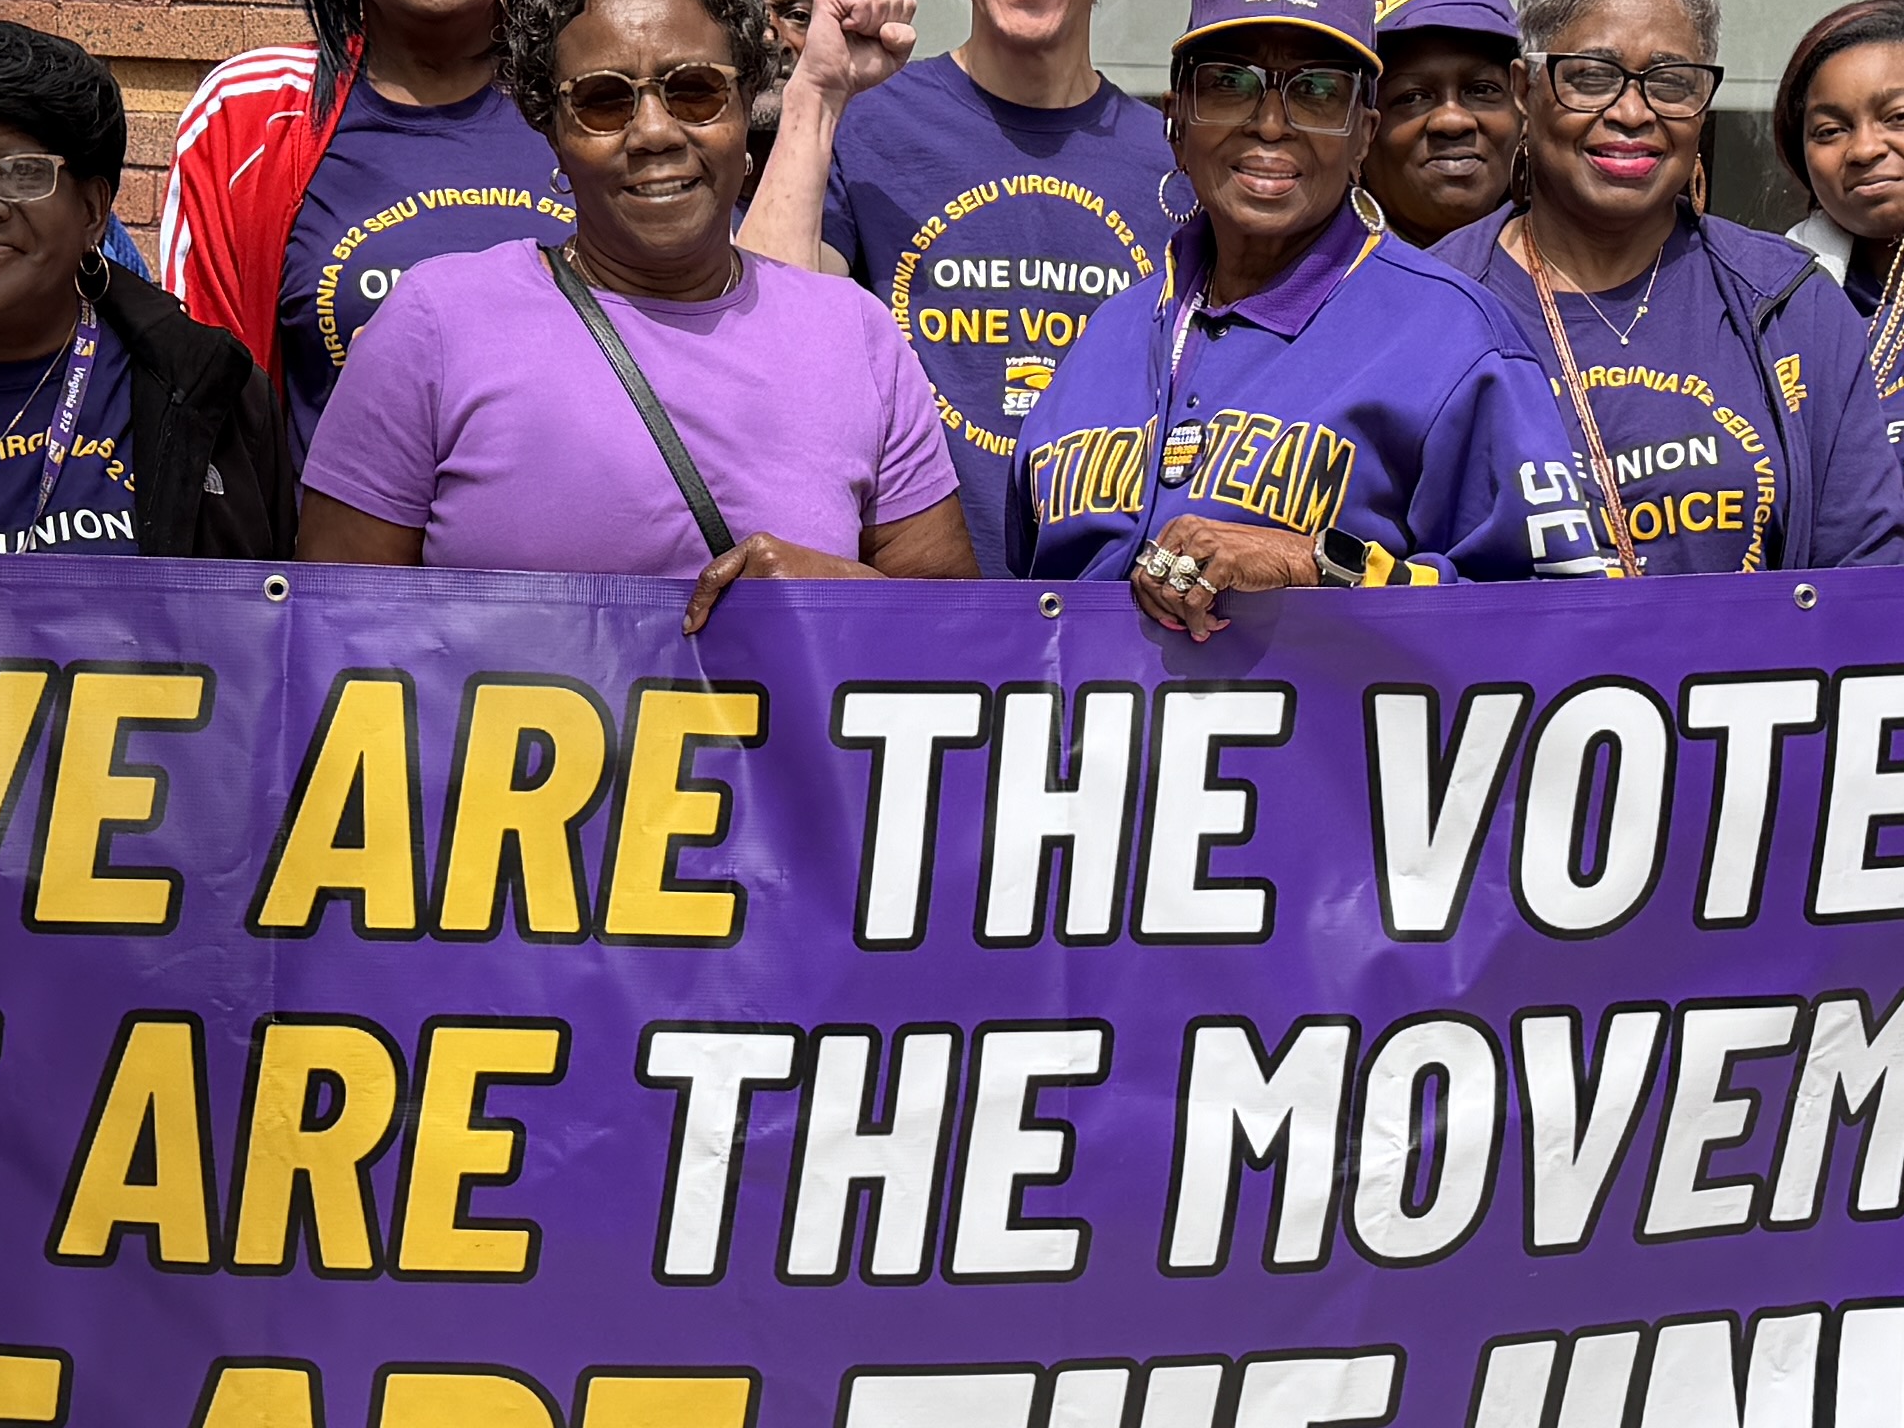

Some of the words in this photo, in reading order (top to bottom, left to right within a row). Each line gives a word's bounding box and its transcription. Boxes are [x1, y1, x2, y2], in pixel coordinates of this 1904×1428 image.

[316, 263, 347, 367] IRGINIA
[332, 226, 368, 260] 512
[363, 196, 419, 233] SEIU
[418, 187, 533, 210] VIRGINIA
[536, 197, 577, 223] 512
[911, 216, 947, 251] 512
[944, 181, 1000, 221] SEIU
[1001, 174, 1105, 217] VIRGINIA
[1105, 210, 1135, 247] 512
[1130, 244, 1155, 279] SE
[934, 258, 1011, 288] ONE
[1019, 259, 1130, 296] UNION
[919, 308, 1010, 344] ONE
[1019, 307, 1088, 346] VOI
[1002, 391, 1040, 409] SEI
[1580, 365, 1679, 393] IRGINIA
[1681, 374, 1715, 406] 512
[1712, 406, 1765, 453] SEIU
[1188, 409, 1356, 536] TEAM
[247, 668, 768, 949] ARE
[831, 679, 1296, 951] THE
[46, 1009, 572, 1284] ARE
[634, 1017, 1111, 1286] THE
